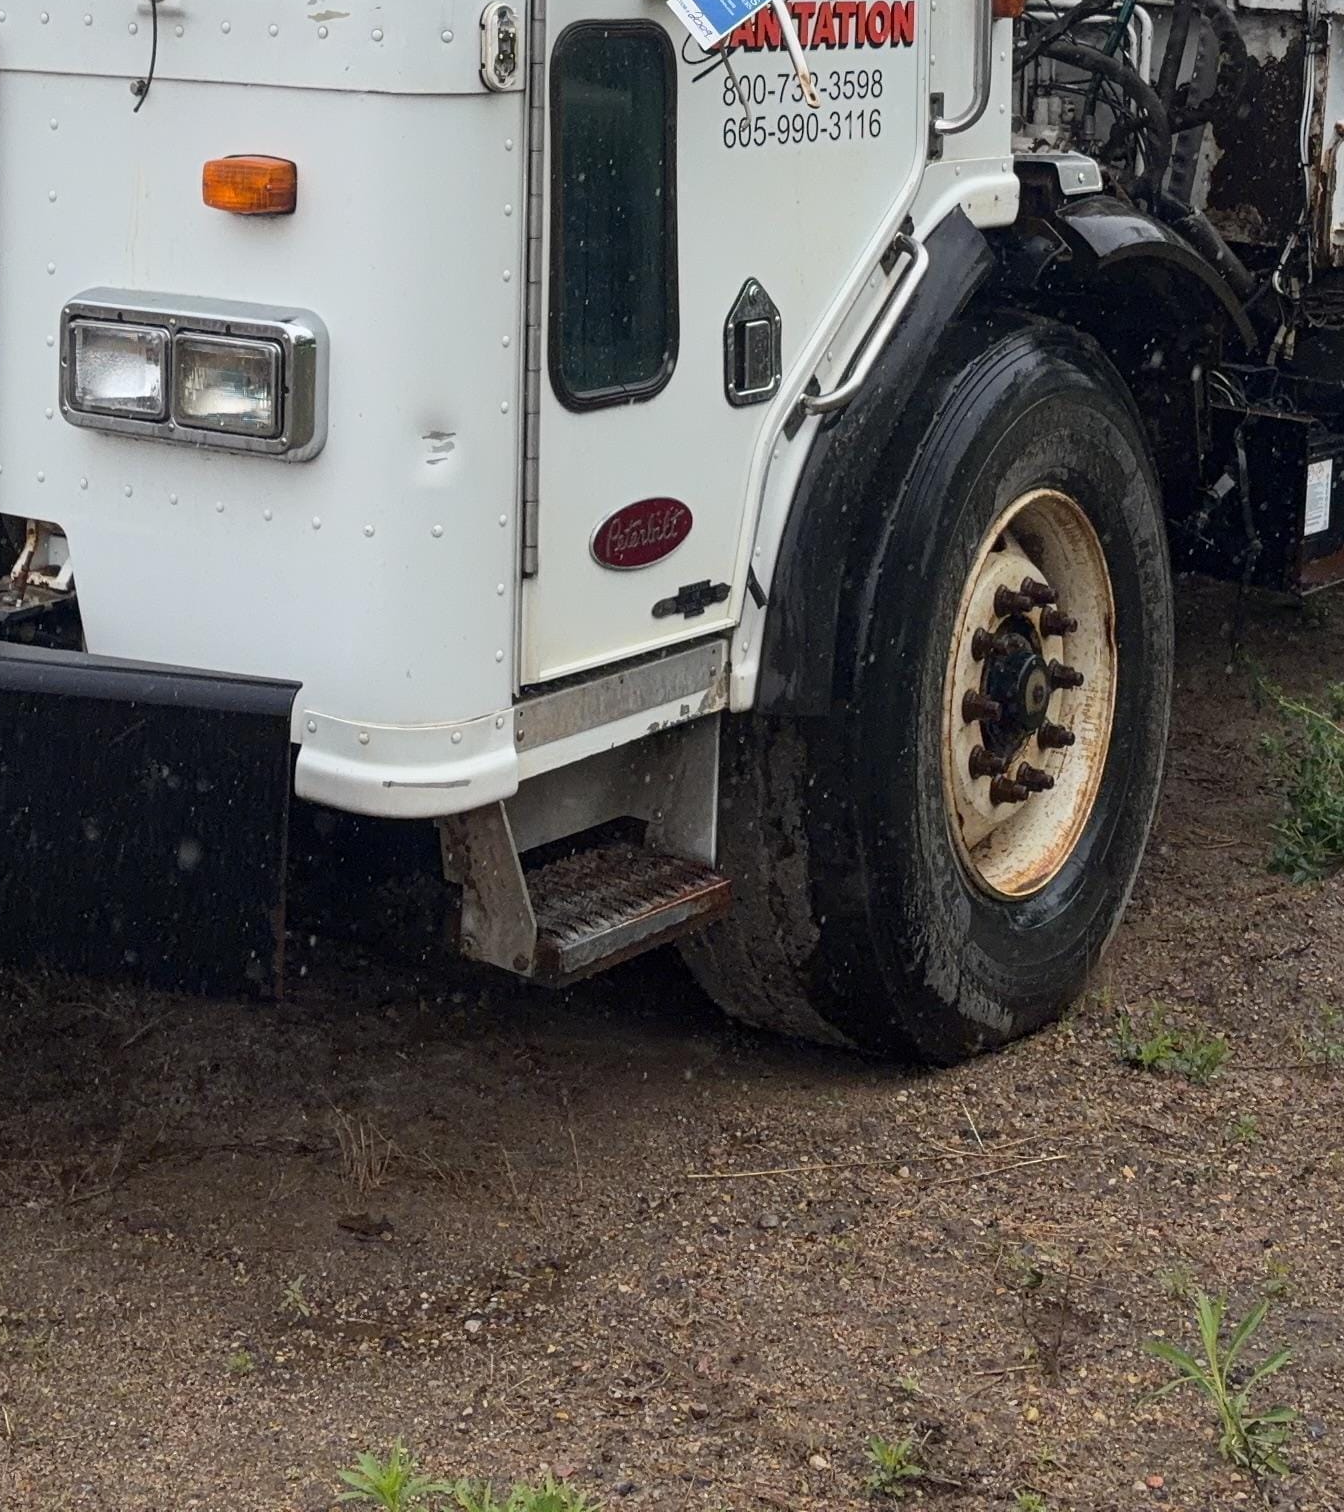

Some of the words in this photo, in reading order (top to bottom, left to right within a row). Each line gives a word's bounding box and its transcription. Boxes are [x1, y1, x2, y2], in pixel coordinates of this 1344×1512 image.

[706, 0, 916, 55] ANTATION
[722, 108, 882, 149] 605-990-3116
[606, 507, 686, 558] Peterbilt
